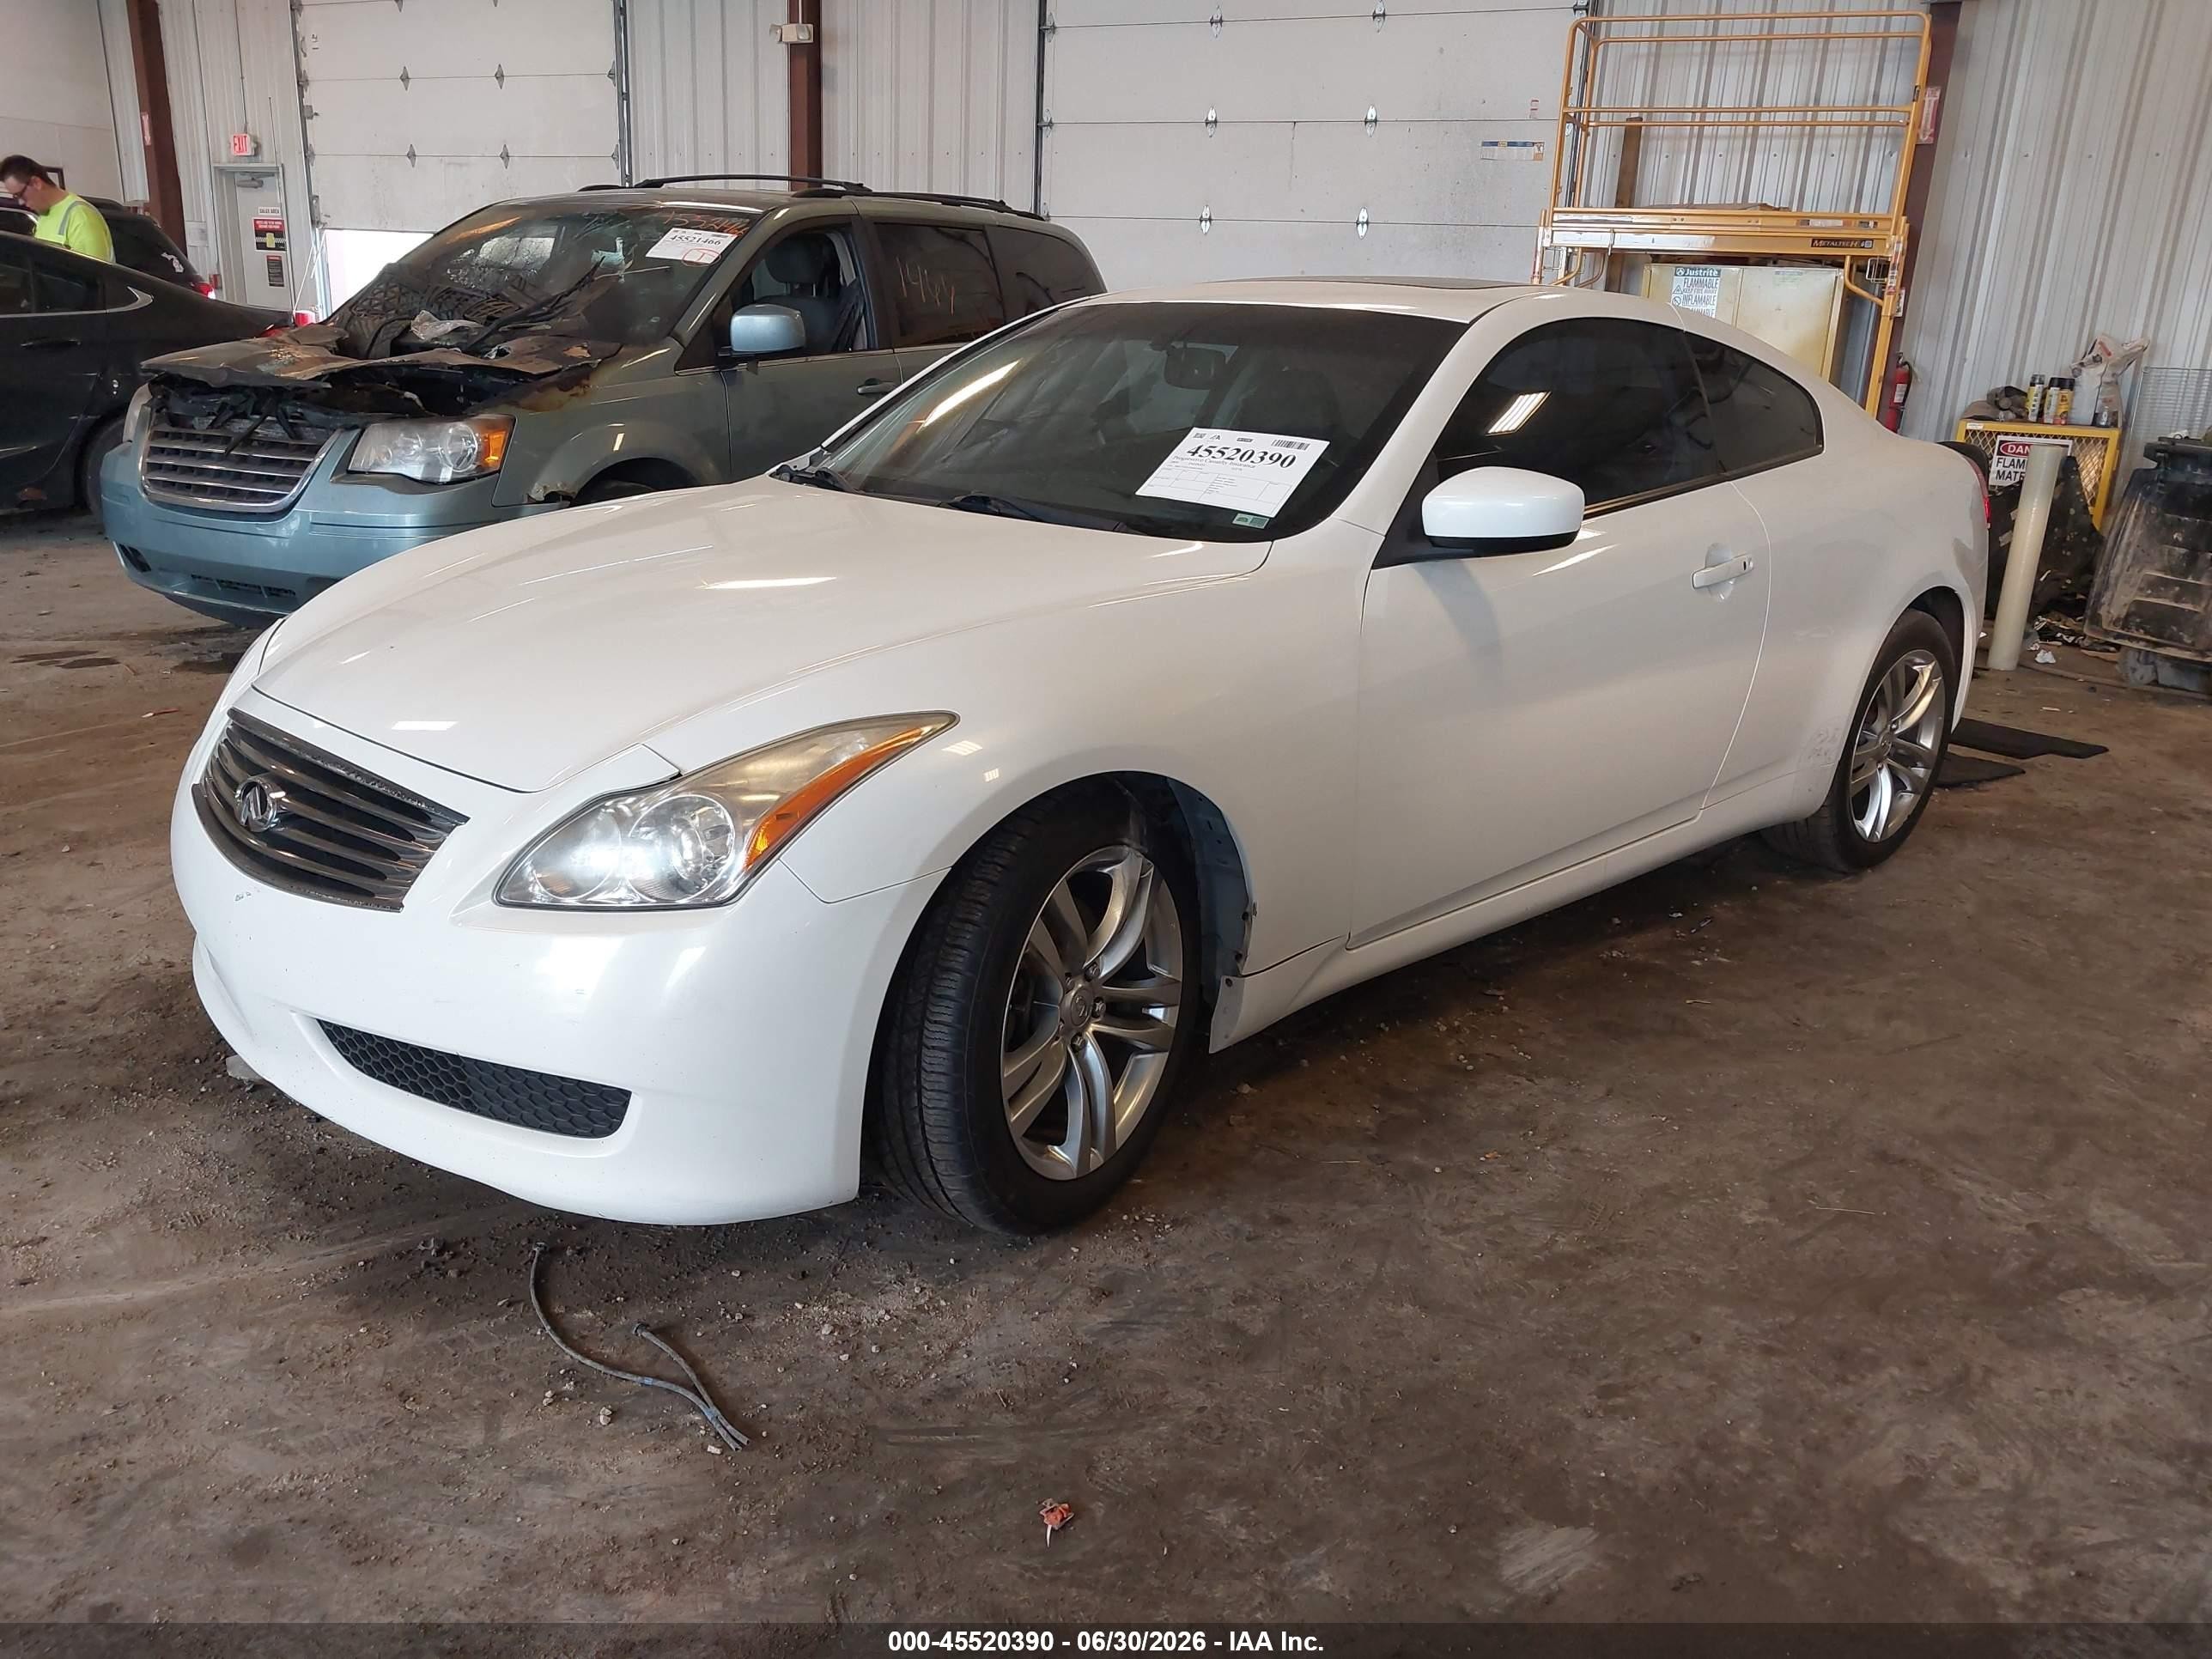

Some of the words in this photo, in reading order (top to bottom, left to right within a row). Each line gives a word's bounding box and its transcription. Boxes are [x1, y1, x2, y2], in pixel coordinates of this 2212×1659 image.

[234, 135, 247, 153] EXIT
[1685, 268, 1718, 276] Justrite
[1683, 277, 1718, 289] FLAMMABLE
[1187, 444, 1297, 469] 45520390
